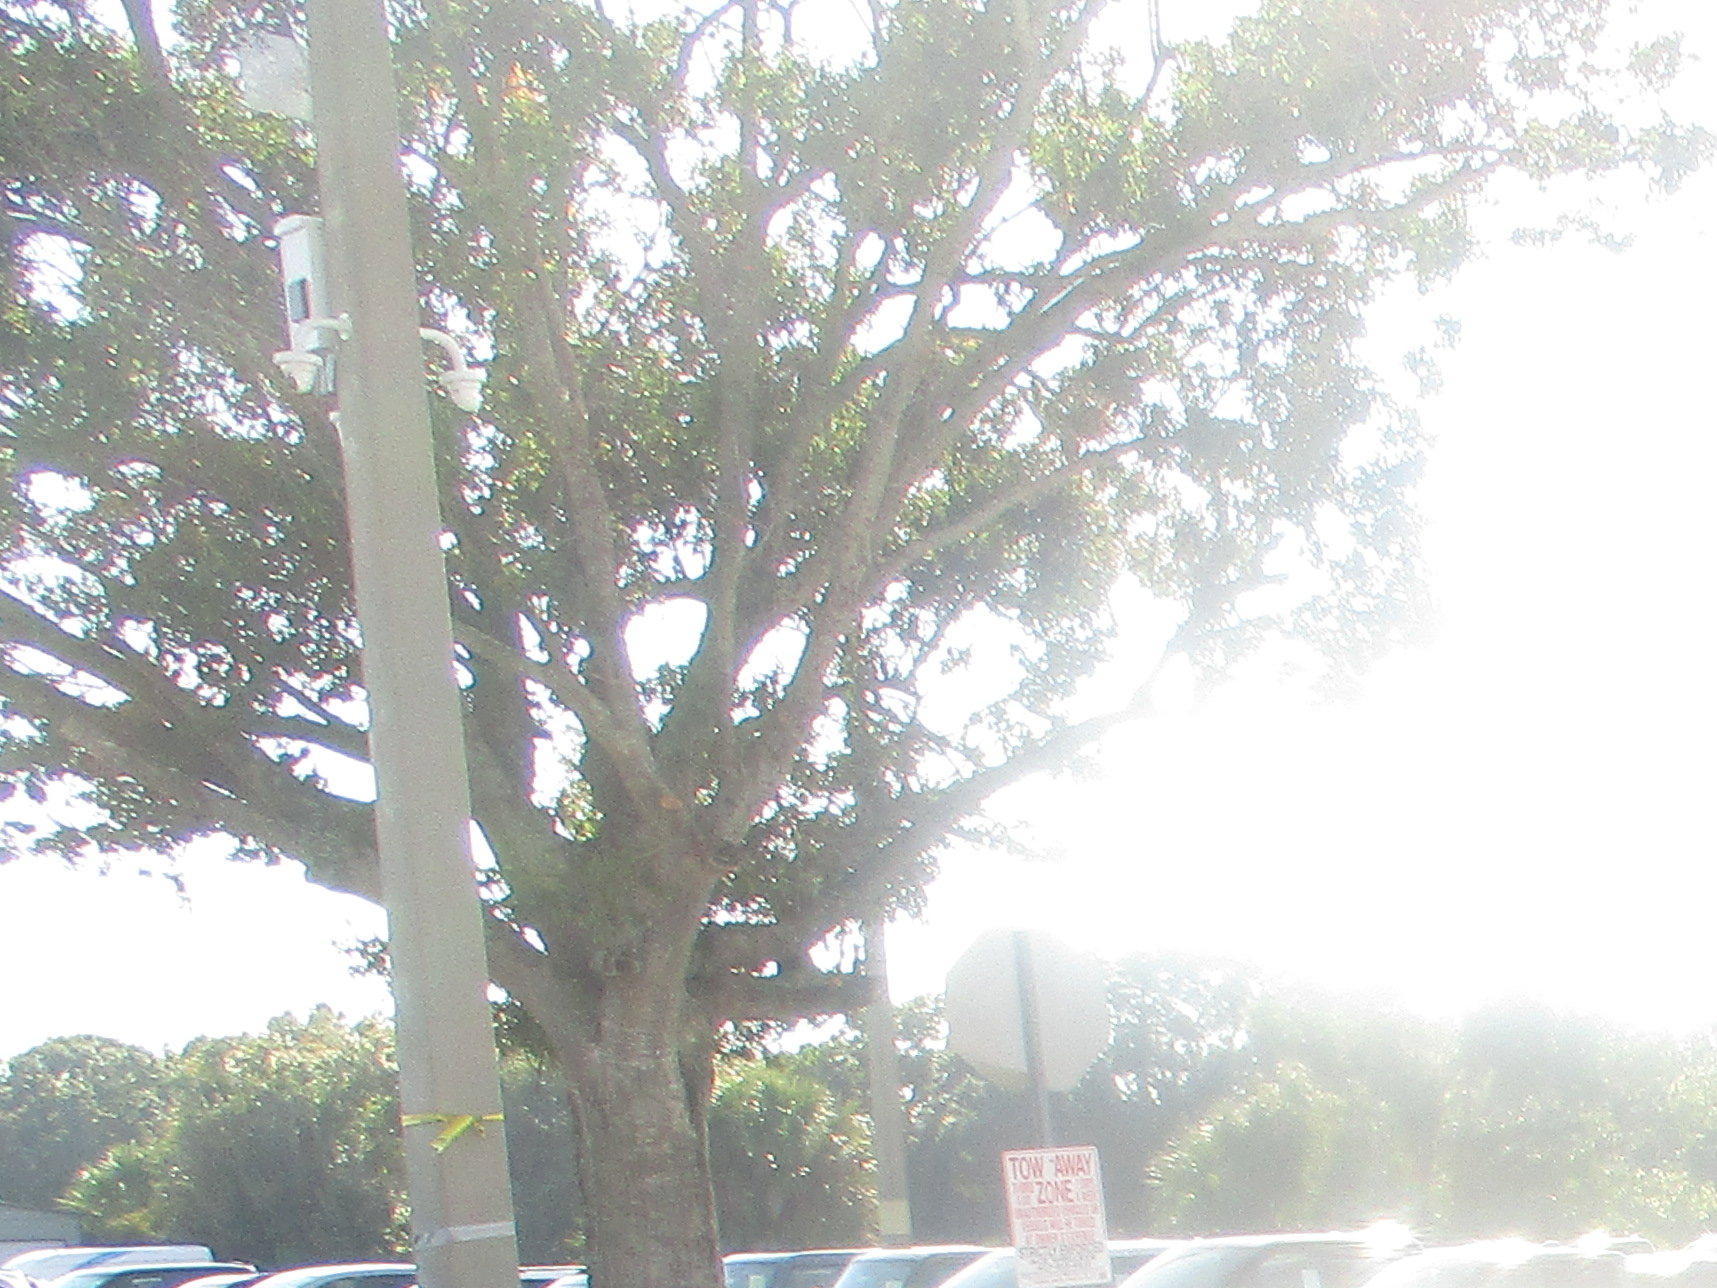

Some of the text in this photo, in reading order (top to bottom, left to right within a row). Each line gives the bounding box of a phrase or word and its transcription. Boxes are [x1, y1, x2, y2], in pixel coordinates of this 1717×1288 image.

[1008, 1152, 1092, 1181] TOW AWAY
[1036, 1179, 1075, 1204] ZONE
